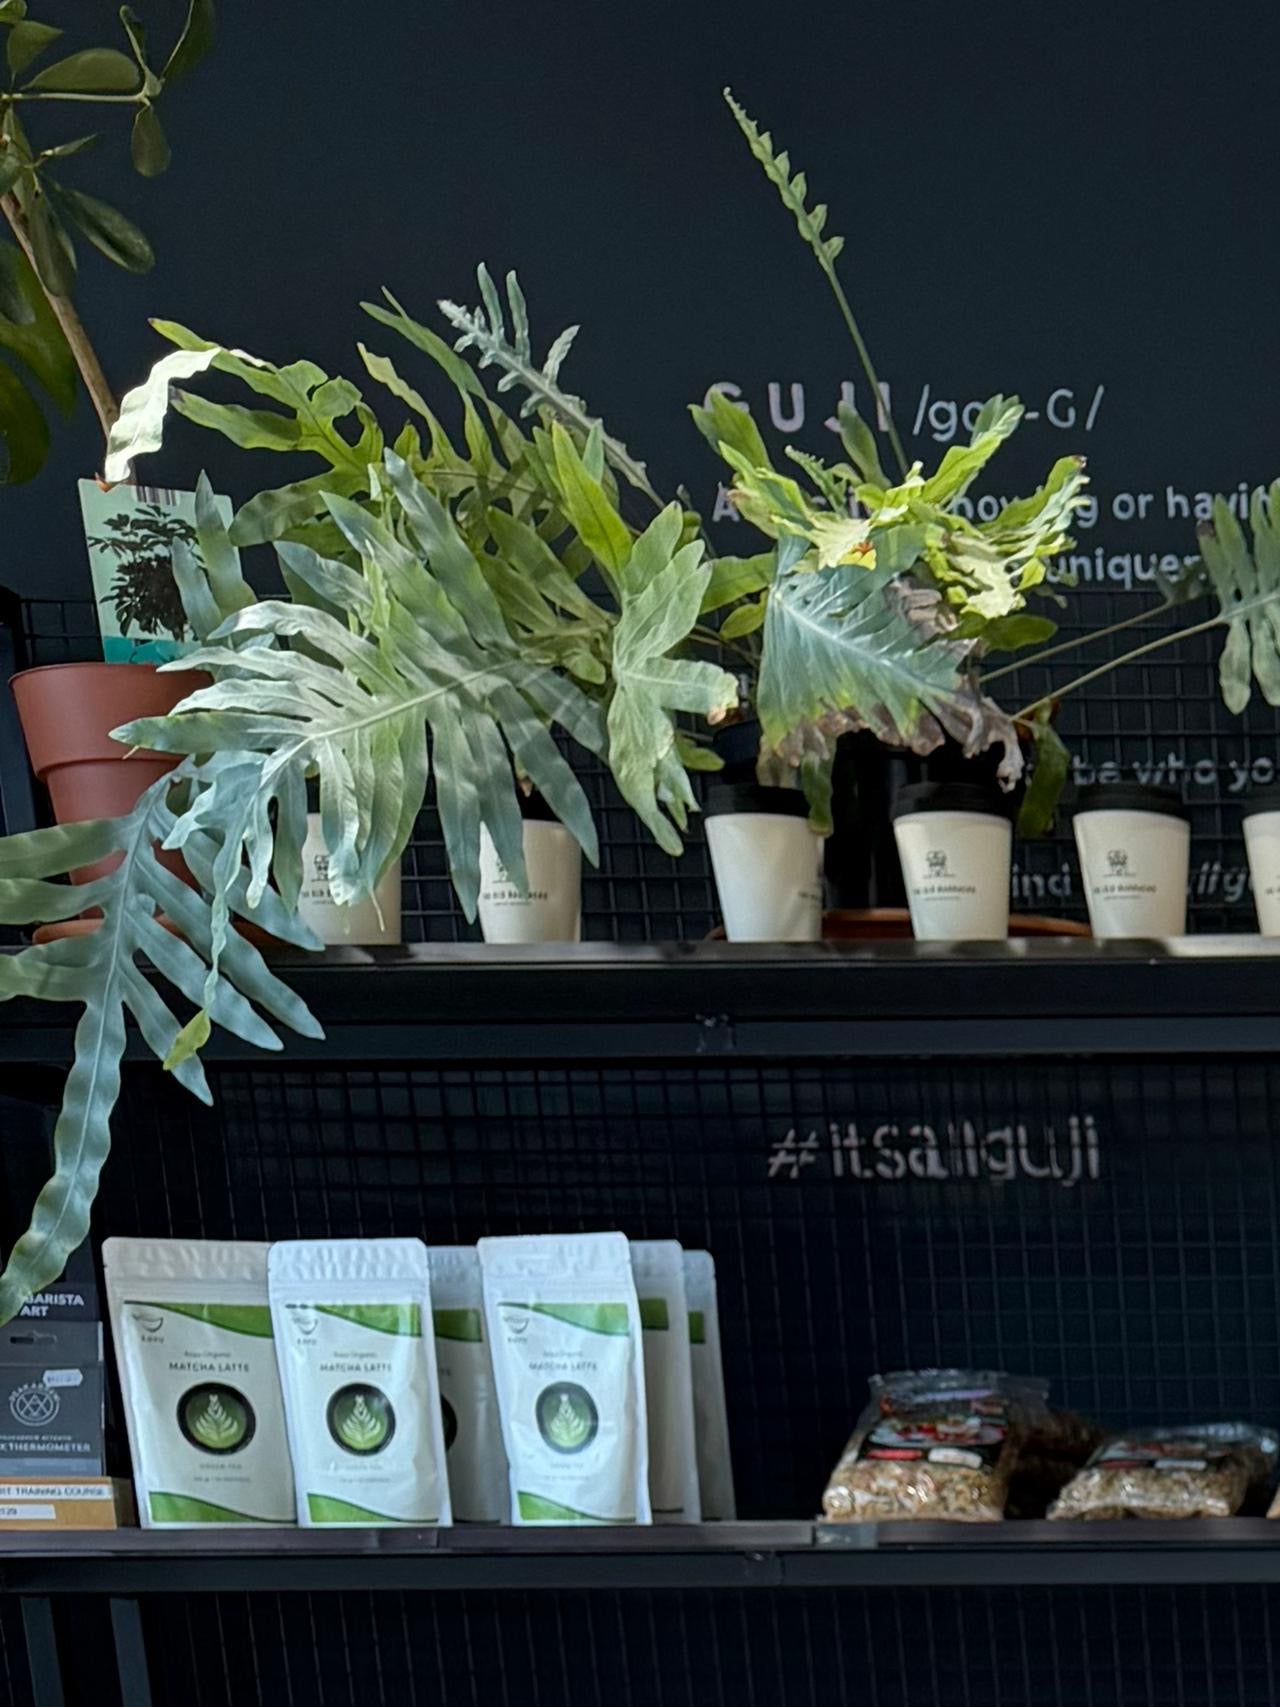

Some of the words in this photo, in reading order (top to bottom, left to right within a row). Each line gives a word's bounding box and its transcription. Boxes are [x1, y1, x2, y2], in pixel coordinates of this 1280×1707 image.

[913, 384, 1104, 441] /go-G/
[1112, 492, 1154, 520] or
[1132, 752, 1216, 785] who
[169, 1361, 215, 1373] MATCHA
[218, 1362, 250, 1373] LATTE
[8, 1442, 91, 1452] THERMOMETER
